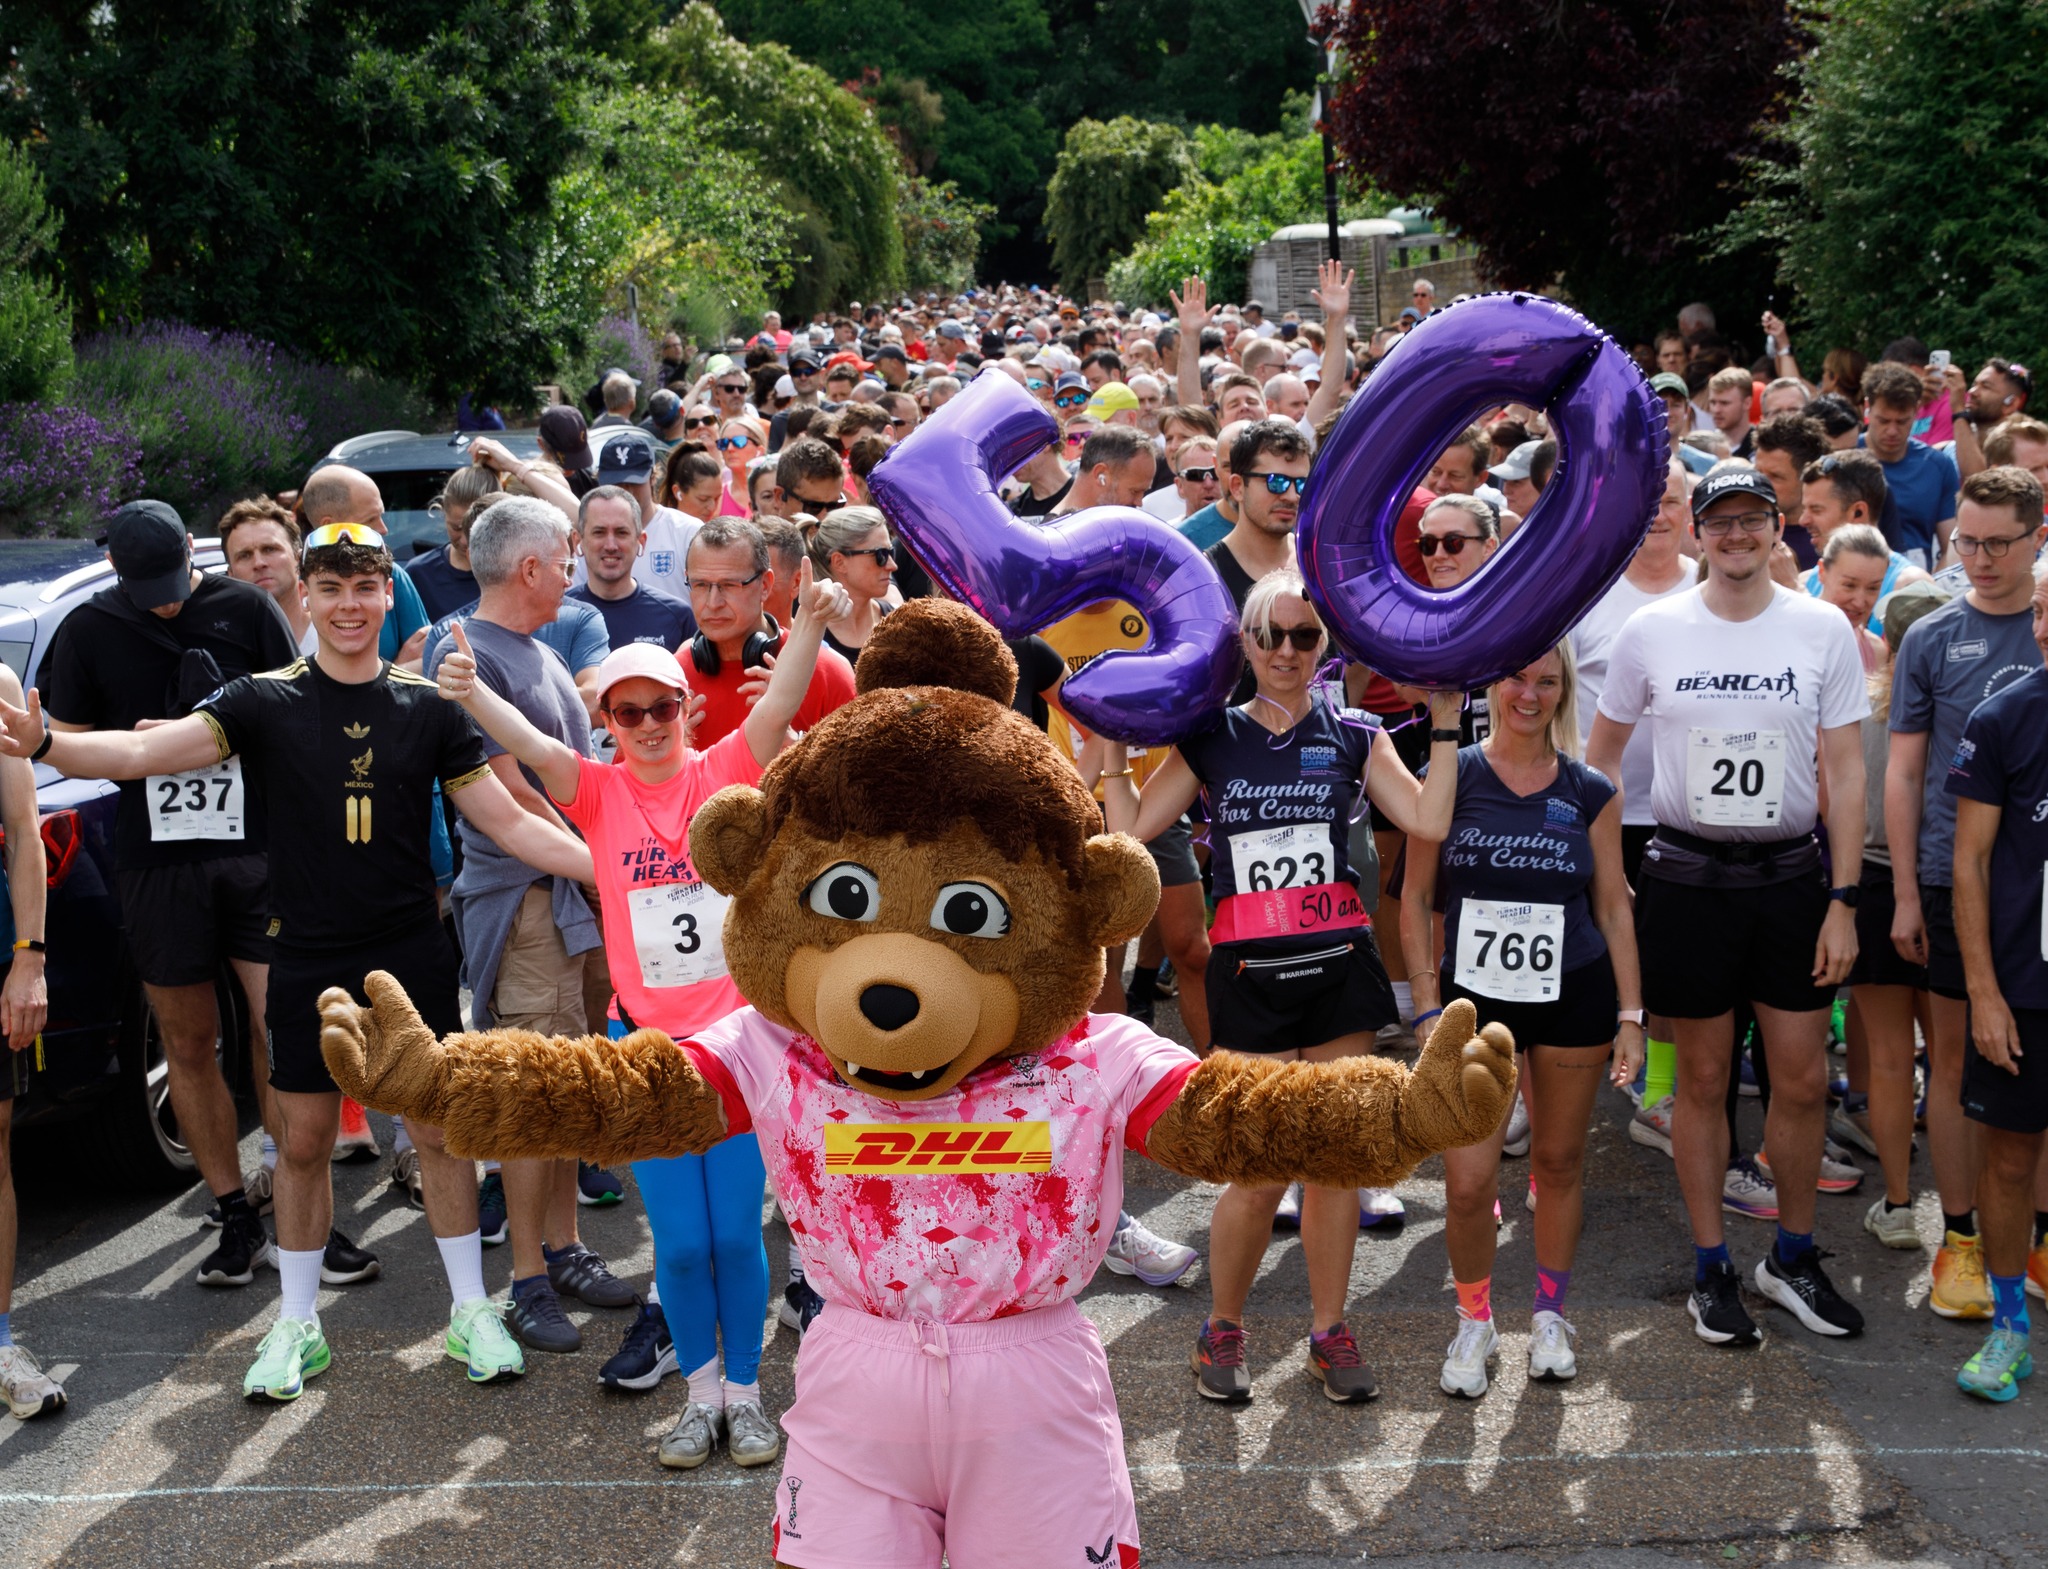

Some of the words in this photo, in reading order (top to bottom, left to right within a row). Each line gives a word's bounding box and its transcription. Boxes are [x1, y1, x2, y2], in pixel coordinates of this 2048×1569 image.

[1707, 474, 1755, 495] HOKA
[1675, 674, 1787, 692] BEARCAT
[1300, 746, 1337, 755] CROSS
[1300, 752, 1337, 762] ROADS
[344, 779, 375, 789] MÉXICO
[1223, 778, 1333, 803] Running
[1710, 758, 1764, 797] 20
[157, 777, 234, 814] 237
[1546, 797, 1579, 814] CROSS
[1218, 801, 1252, 824] For
[1258, 798, 1336, 821] Carers
[1454, 827, 1570, 858] Running
[1248, 851, 1326, 893] 623
[1443, 846, 1479, 867] For
[1489, 848, 1577, 873] Carers
[1264, 899, 1277, 929] HAPPY
[1273, 891, 1291, 933] BIRTHDAY
[1299, 891, 1332, 929] 50
[671, 913, 702, 955] 3
[1473, 928, 1555, 973] 766
[1286, 966, 1324, 979] KARRIMOR
[853, 1131, 1025, 1165] DHL
